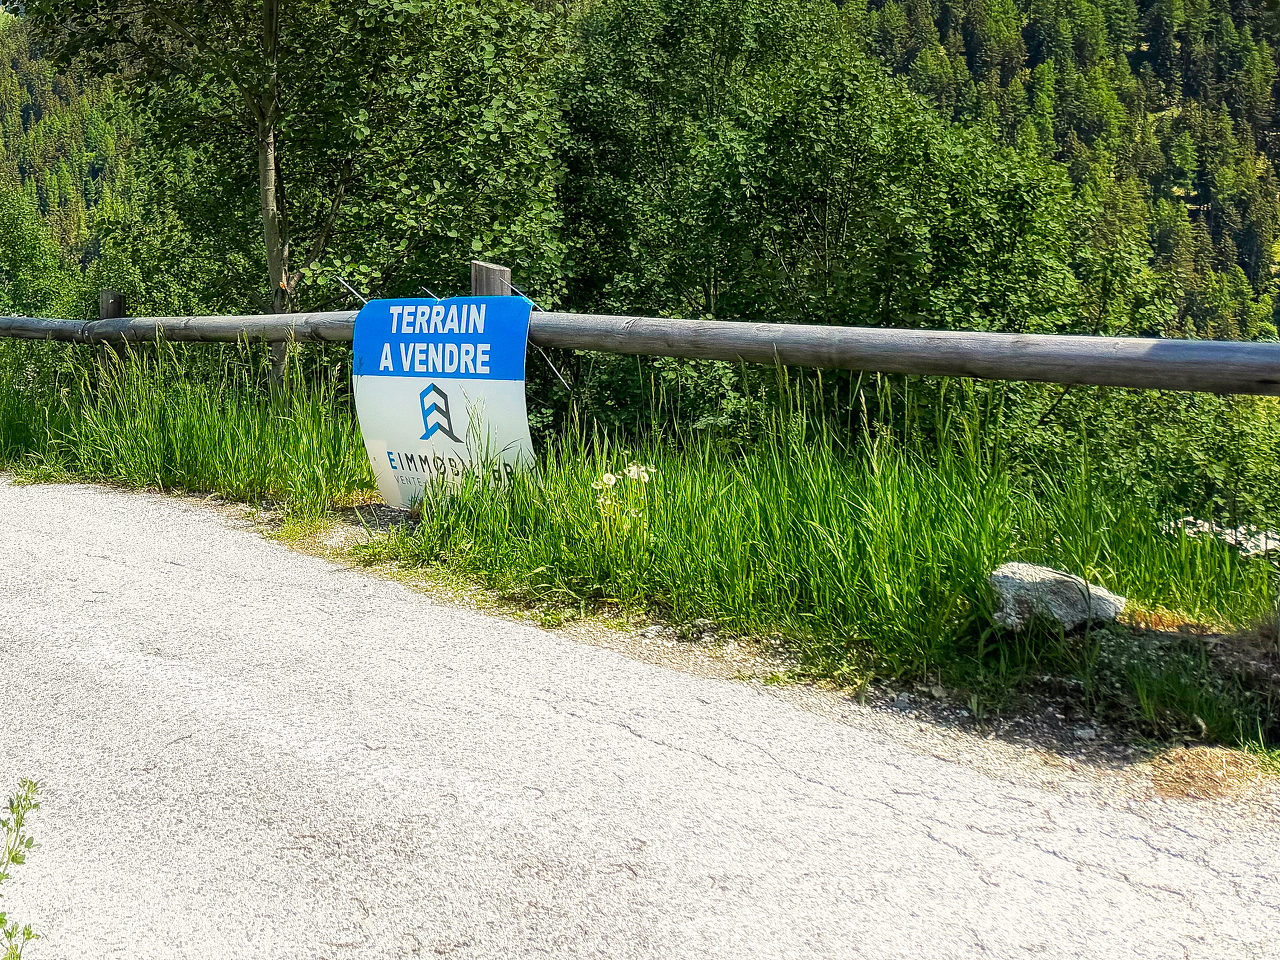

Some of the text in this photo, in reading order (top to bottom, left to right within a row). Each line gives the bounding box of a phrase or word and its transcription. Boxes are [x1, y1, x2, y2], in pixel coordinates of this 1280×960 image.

[389, 304, 487, 334] TERRAIN
[378, 342, 491, 375] A VENDRE
[393, 474, 423, 487] VENTE
